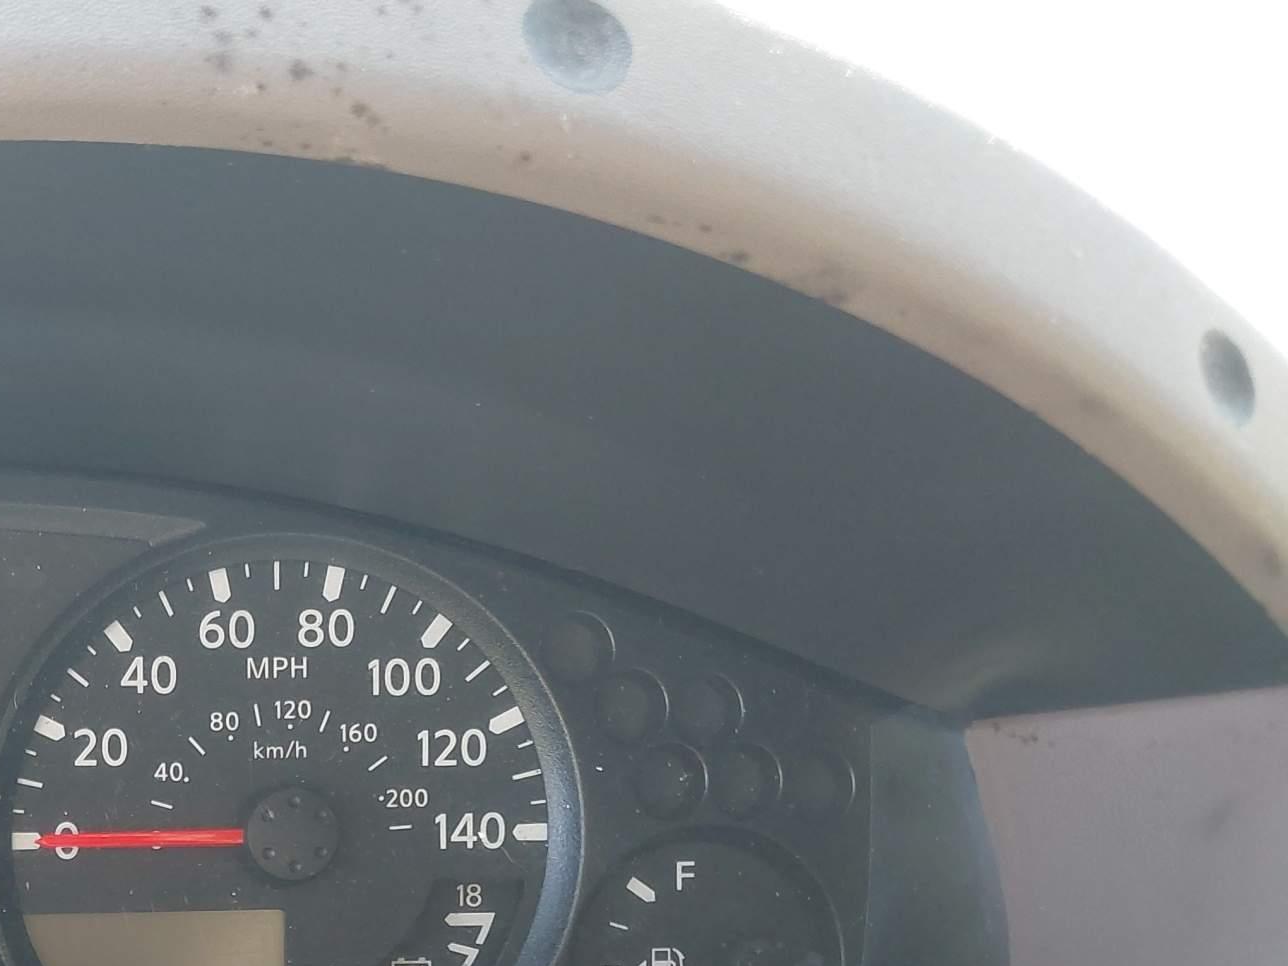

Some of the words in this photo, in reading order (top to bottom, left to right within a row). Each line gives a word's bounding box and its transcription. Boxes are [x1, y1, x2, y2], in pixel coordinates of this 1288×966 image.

[200, 609, 255, 648] 60
[297, 609, 354, 648] 80
[120, 655, 177, 695] 40
[247, 657, 308, 680] MPH
[368, 658, 441, 697] 100
[210, 711, 239, 732] 80
[274, 700, 312, 720] 120
[74, 728, 128, 767] 20
[340, 723, 378, 743] 160
[416, 729, 487, 767] 120
[253, 740, 307, 760] km/h
[386, 788, 428, 808] 200
[434, 812, 506, 850] 140
[676, 861, 696, 891] F
[456, 884, 482, 907] 18
